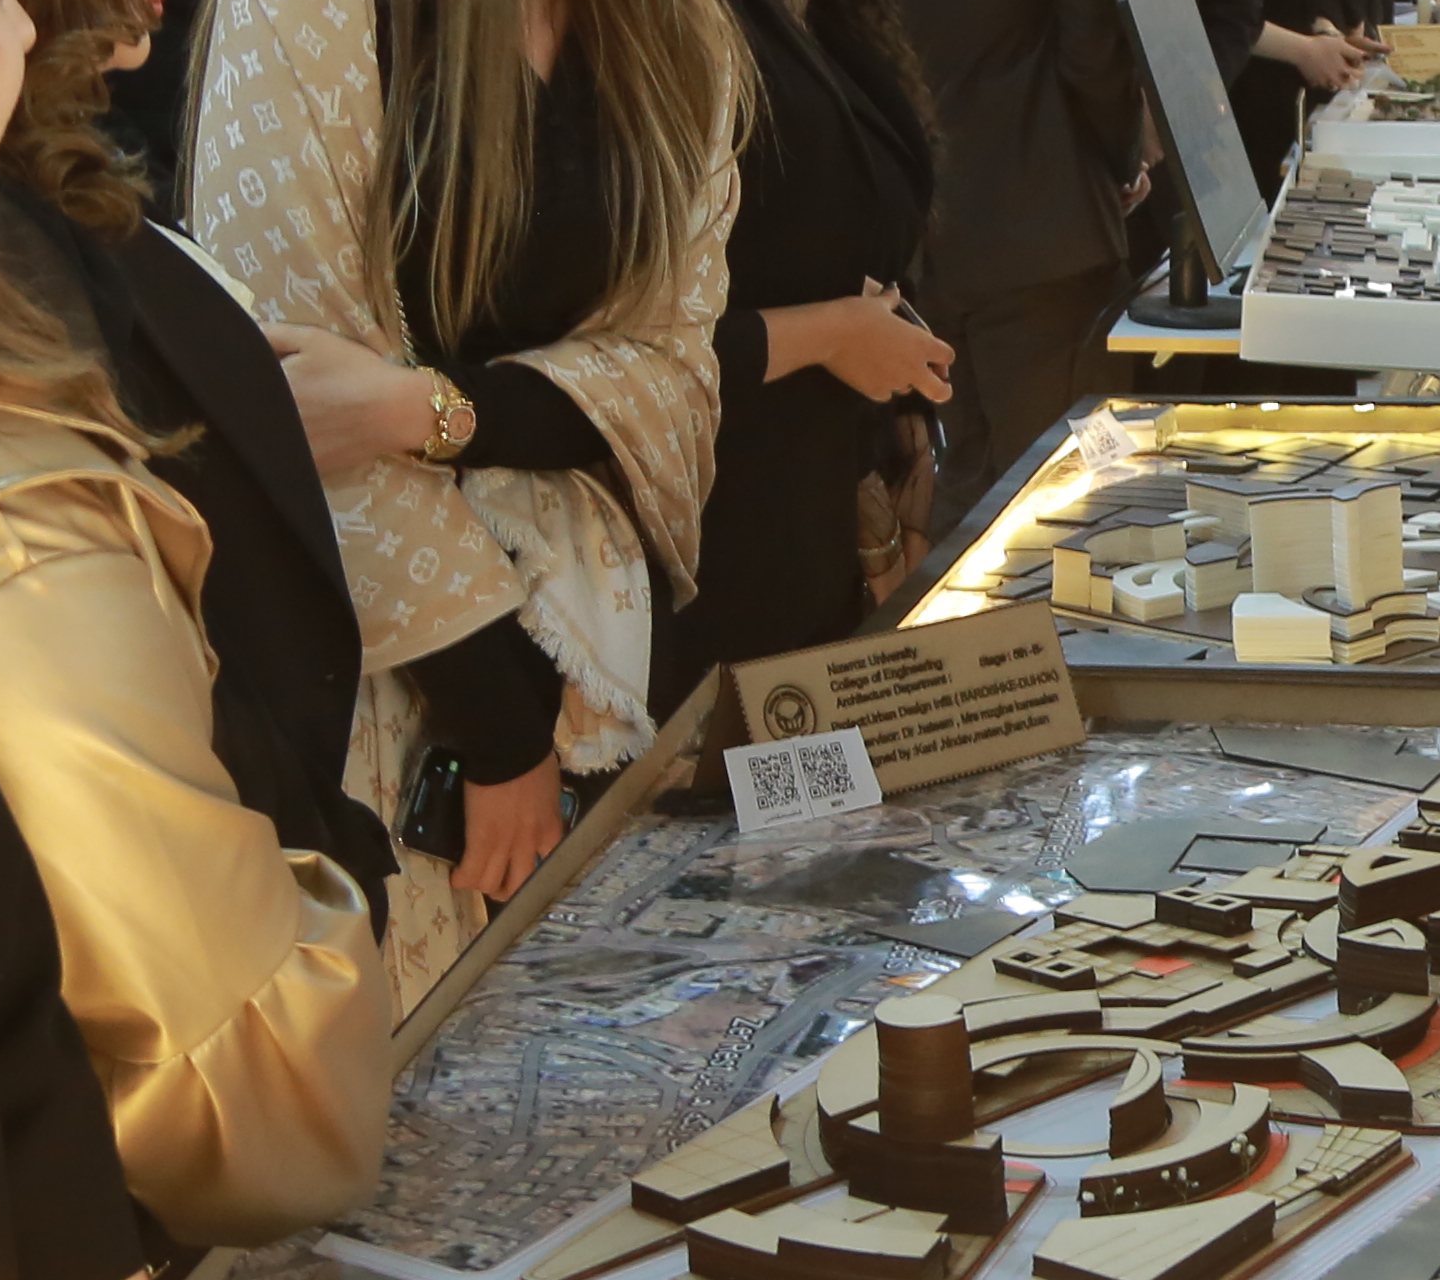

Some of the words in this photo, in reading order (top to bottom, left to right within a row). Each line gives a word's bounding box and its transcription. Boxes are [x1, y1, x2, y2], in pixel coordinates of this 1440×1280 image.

[867, 646, 918, 668] University
[829, 674, 869, 692] College
[870, 671, 881, 682] of
[882, 657, 943, 680] Engineering
[835, 687, 892, 708] Architecture
[897, 699, 932, 717] Design
